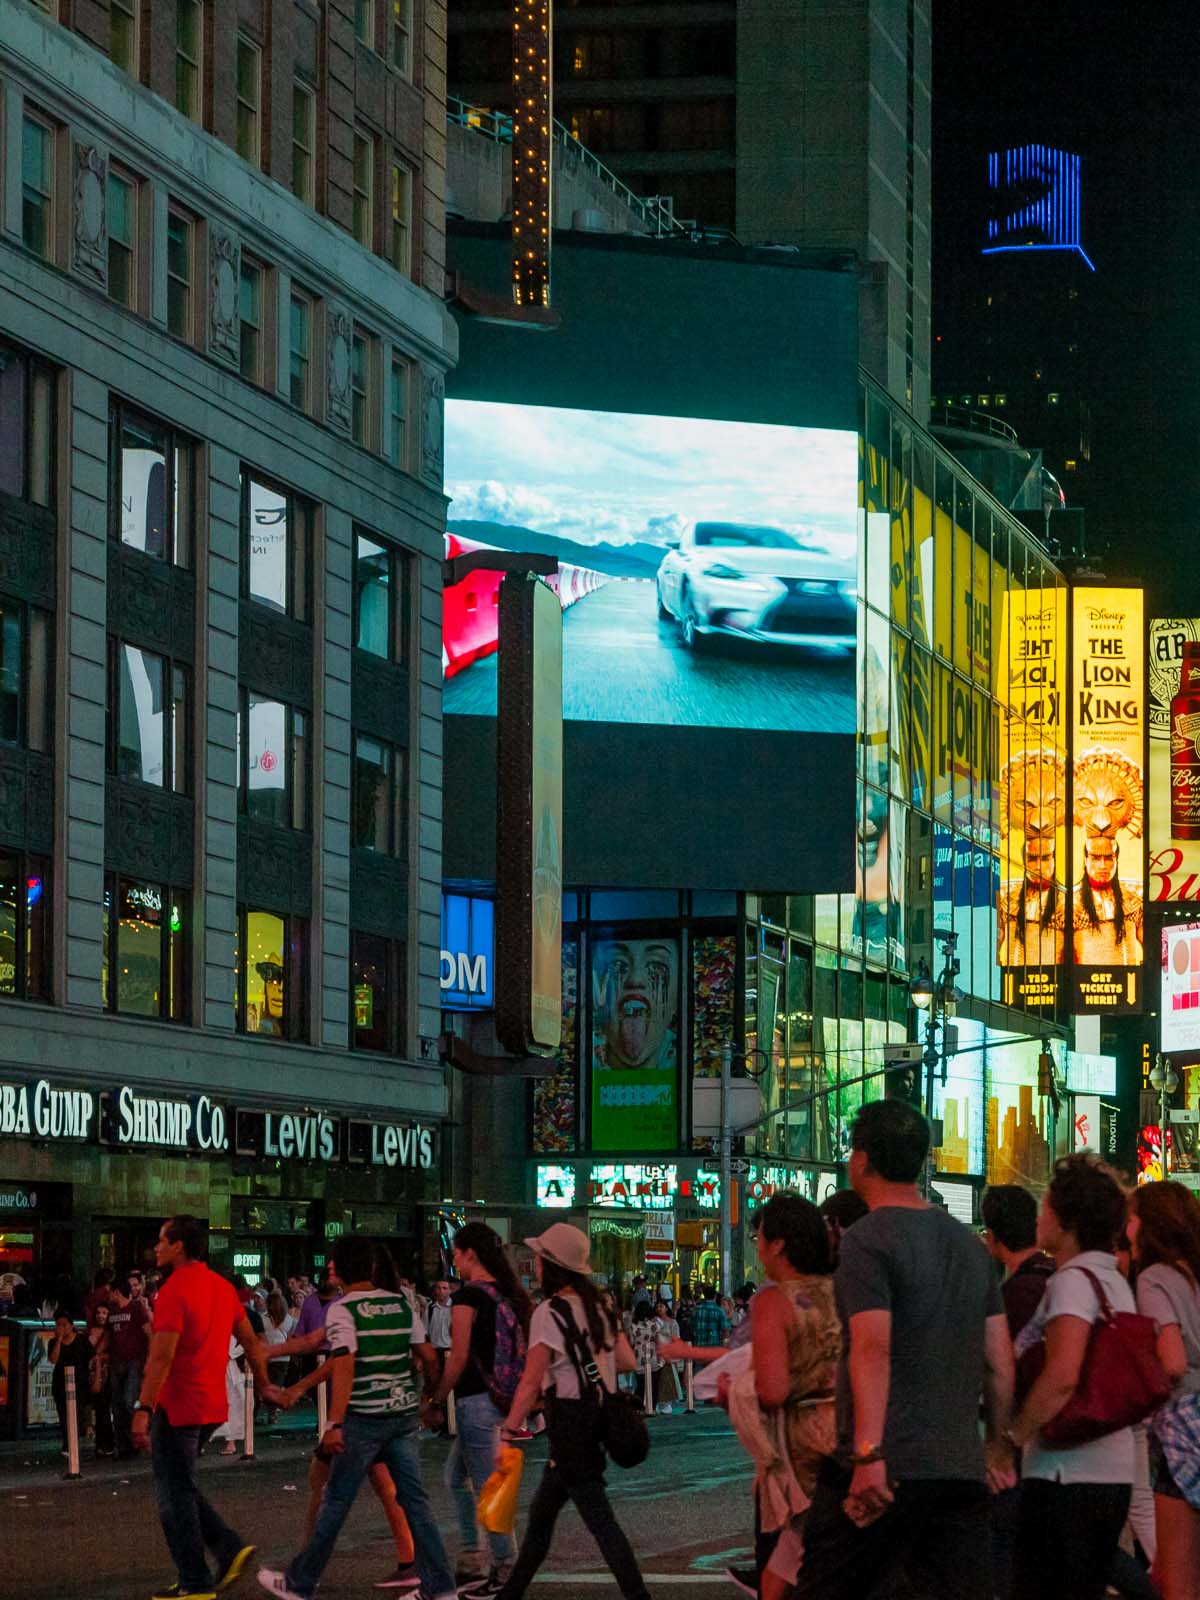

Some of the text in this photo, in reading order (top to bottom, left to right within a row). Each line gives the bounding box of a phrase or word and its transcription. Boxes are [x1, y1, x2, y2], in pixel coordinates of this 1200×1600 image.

[1085, 606, 1126, 624] Disney
[1089, 639, 1123, 655] THE
[1083, 660, 1131, 688] LION
[1080, 692, 1137, 726] KING
[1091, 974, 1112, 983] GET
[1080, 984, 1122, 993] TICKETS
[1085, 995, 1117, 1005] HERE!
[34, 1080, 93, 1137] GUMP
[119, 1086, 192, 1146] SHRIMP
[1109, 1112, 1117, 1153] NOVOTEL
[588, 1181, 715, 1197] OAKLEY
